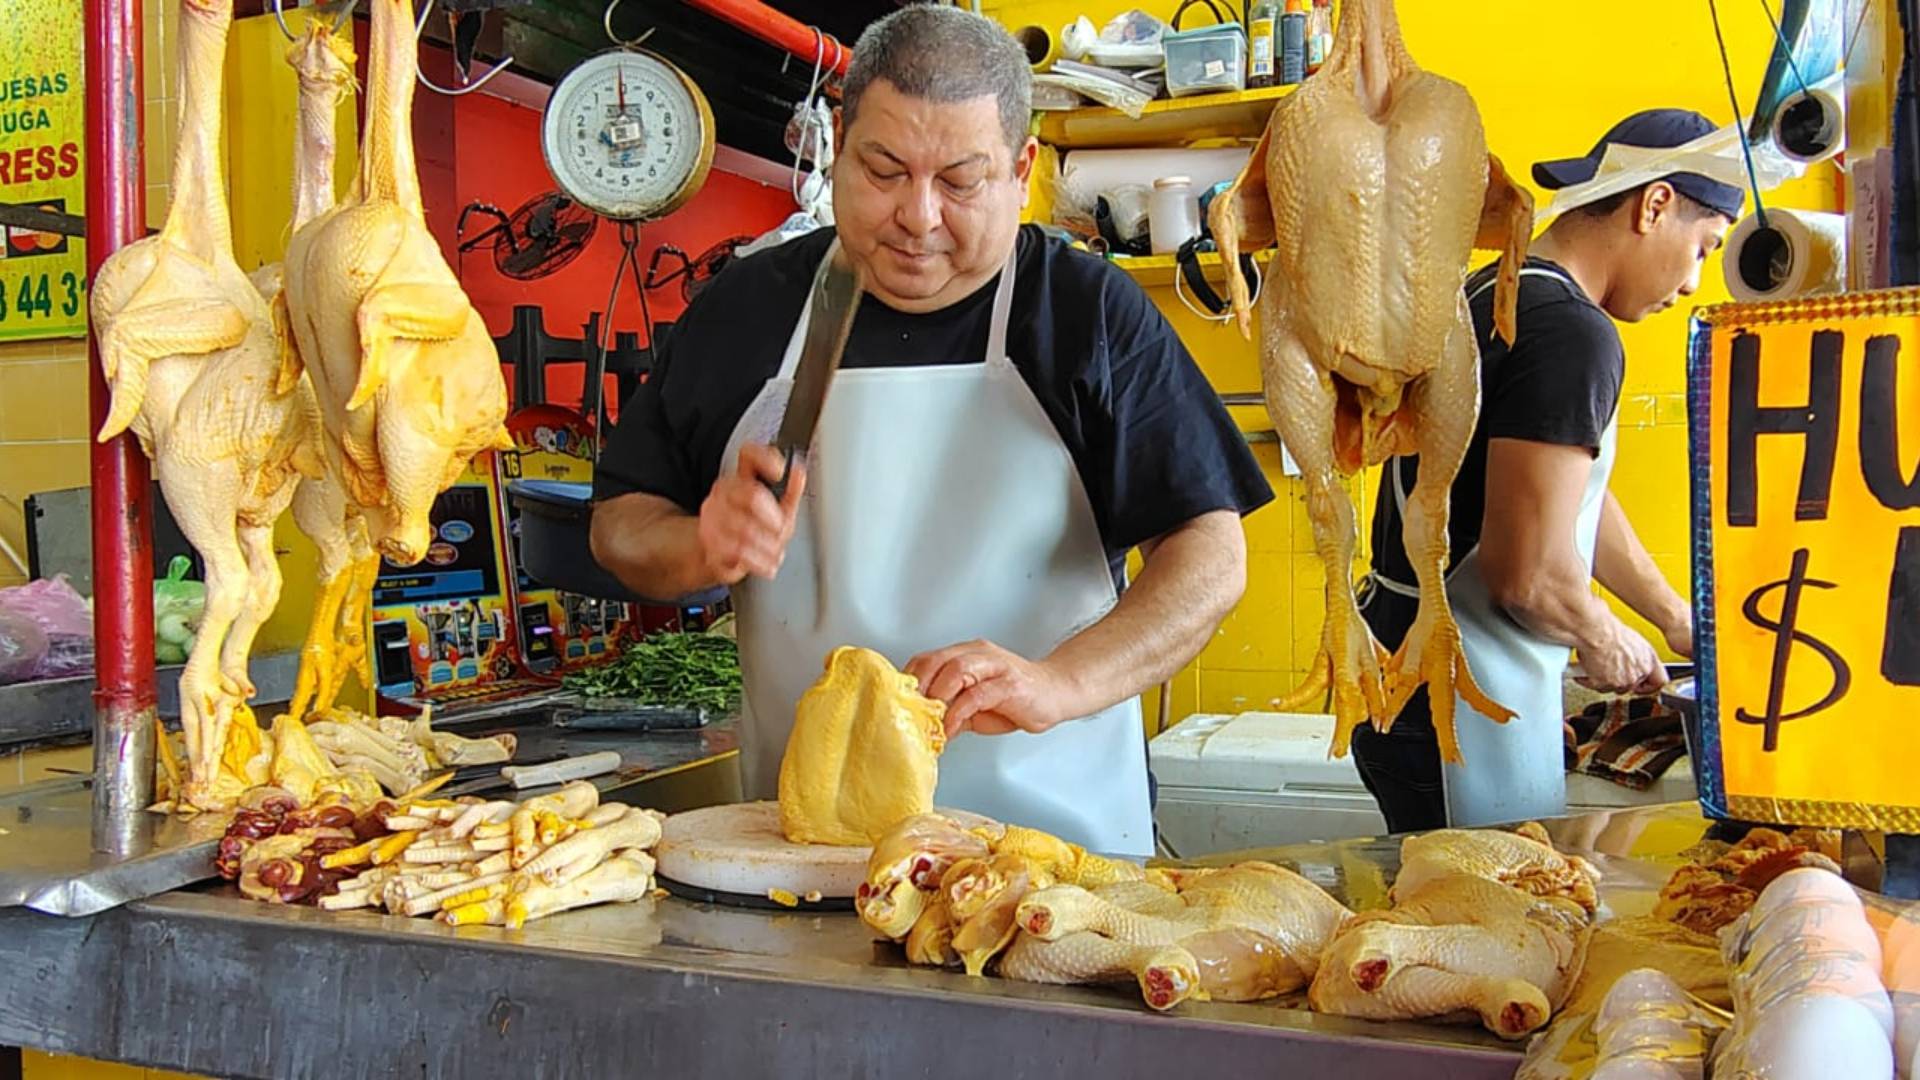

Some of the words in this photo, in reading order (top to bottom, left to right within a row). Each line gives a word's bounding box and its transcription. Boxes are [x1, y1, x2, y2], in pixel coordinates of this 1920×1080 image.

[17, 274, 52, 319] 44
[61, 271, 86, 317] 3
[504, 453, 520, 476] 16
